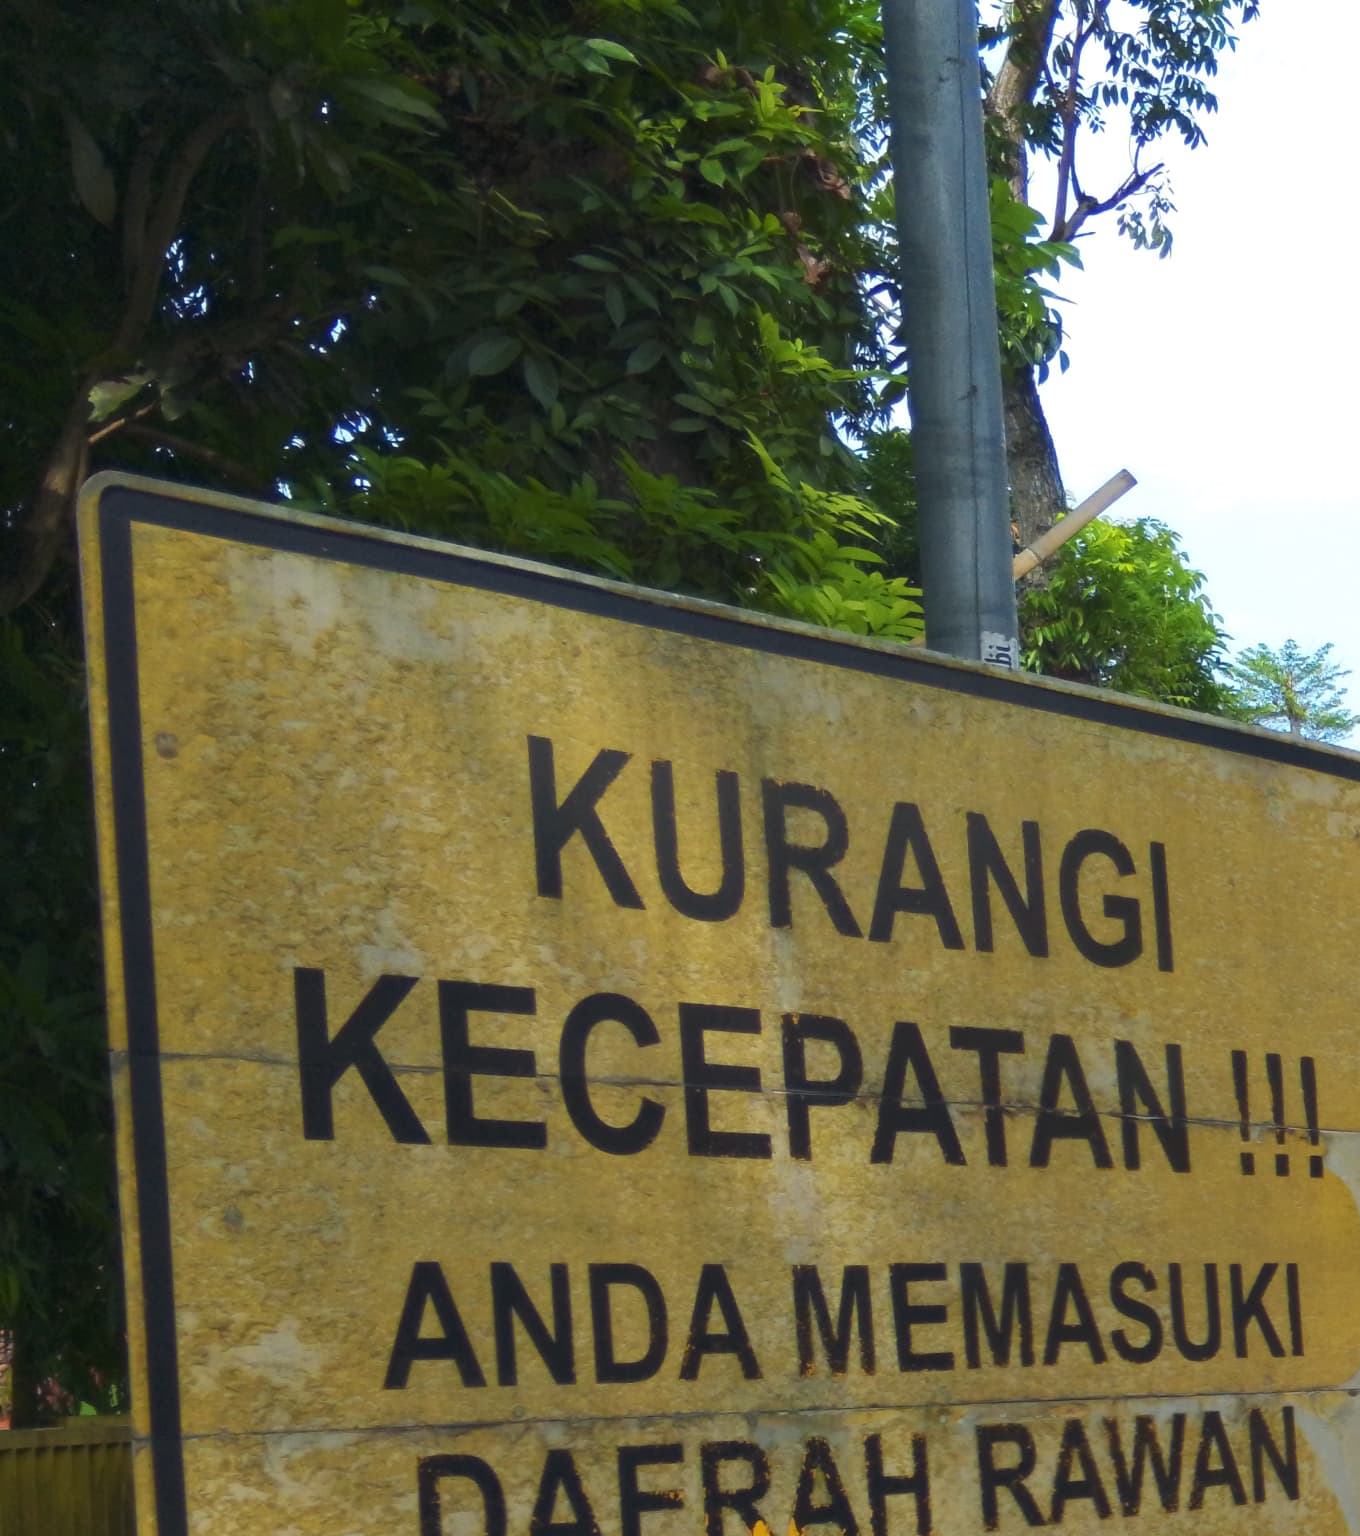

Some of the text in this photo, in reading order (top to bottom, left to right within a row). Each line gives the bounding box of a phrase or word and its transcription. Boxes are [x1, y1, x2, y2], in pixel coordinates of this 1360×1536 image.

[528, 734, 1174, 973] KURANGI
[293, 965, 1324, 1179] KECEPATAN !!!
[383, 1261, 1304, 1391] ANDA MEMASUKI
[975, 1405, 1300, 1533] RAWAN
